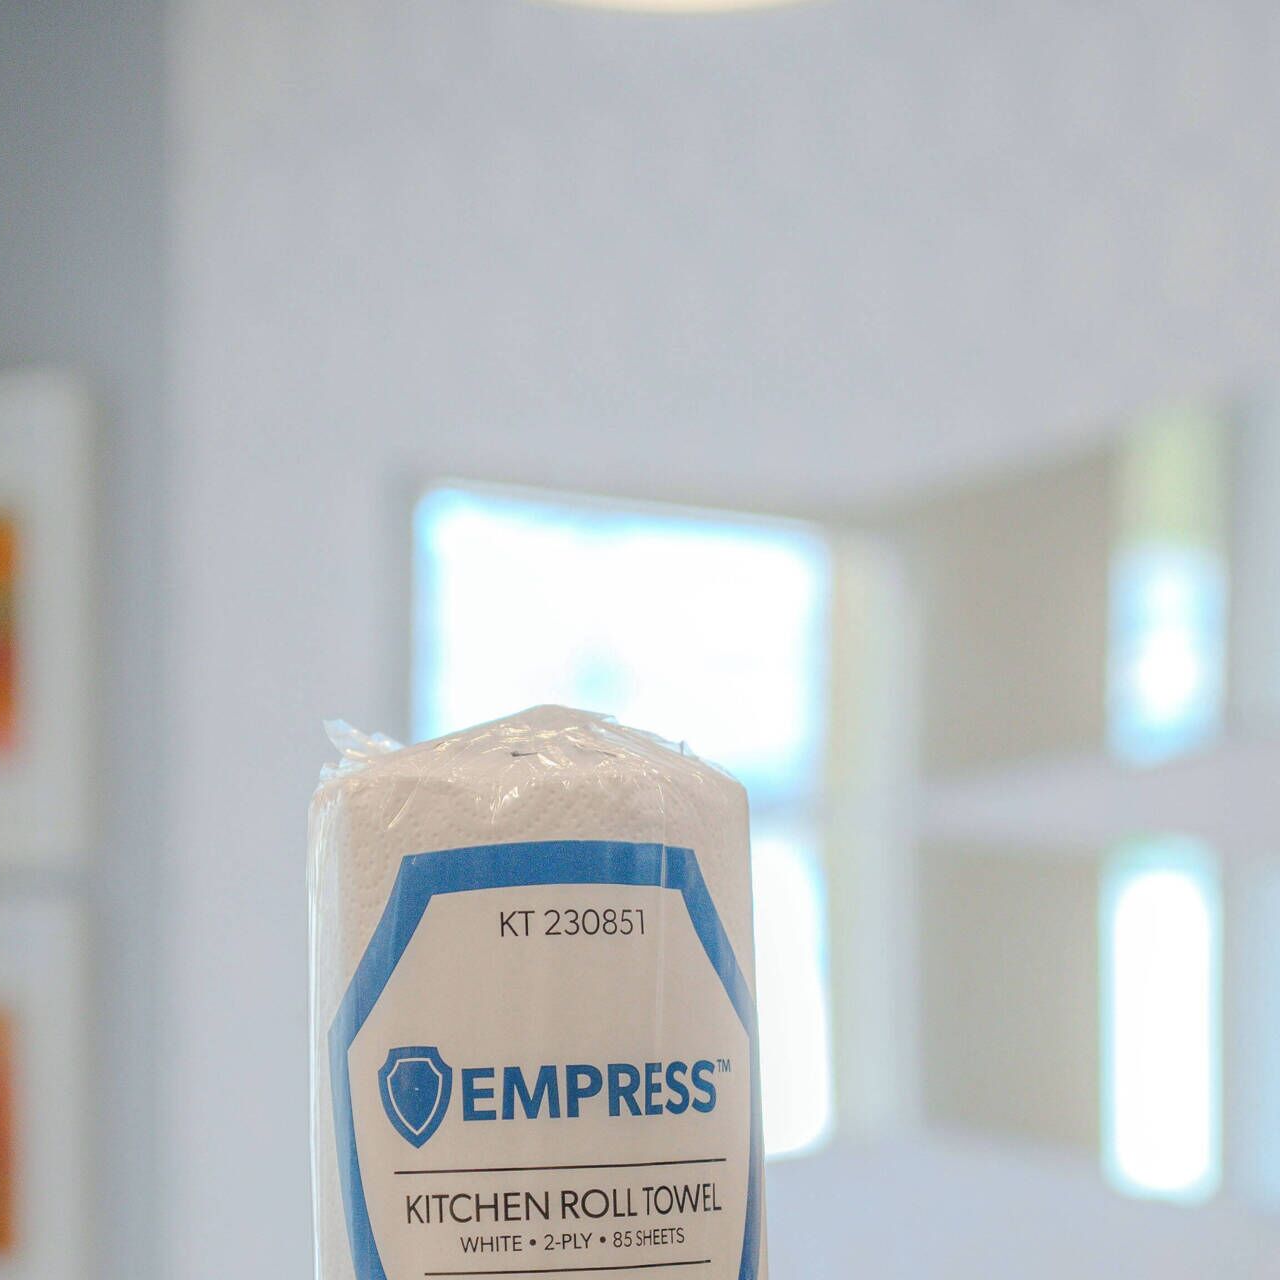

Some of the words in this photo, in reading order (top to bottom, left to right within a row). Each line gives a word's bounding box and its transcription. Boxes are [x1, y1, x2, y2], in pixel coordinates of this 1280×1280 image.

[500, 909, 535, 937] KT
[544, 908, 646, 936] 230851
[406, 1190, 550, 1224] KITCHEN
[561, 1187, 638, 1219] ROLL
[642, 1182, 722, 1217] TOWEL
[460, 1234, 523, 1254] WHITE
[544, 1232, 593, 1251] 2-PLY
[613, 1230, 633, 1249] 85
[635, 1227, 686, 1247] SHEETS
